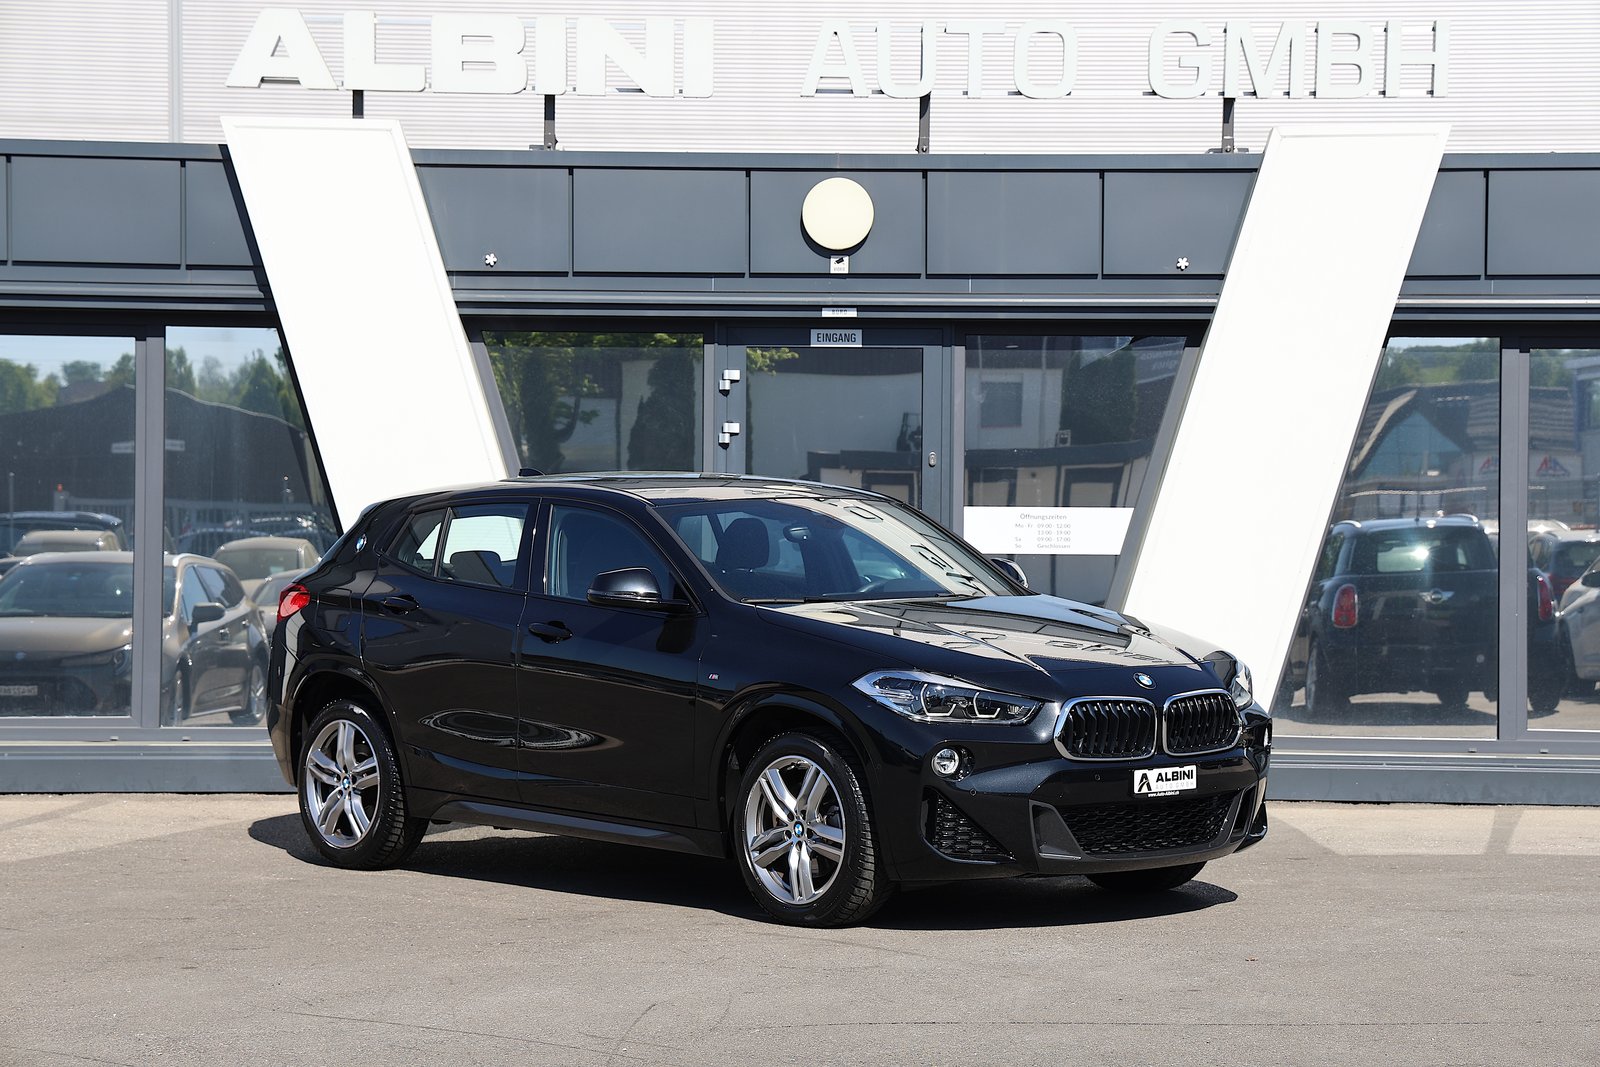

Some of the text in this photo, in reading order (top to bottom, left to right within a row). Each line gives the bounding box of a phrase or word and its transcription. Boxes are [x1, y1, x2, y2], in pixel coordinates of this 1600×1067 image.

[224, 8, 1450, 100] ALBINI AUTO GMBH
[816, 332, 857, 343] EINGANG
[1156, 769, 1194, 783] ALBINI
